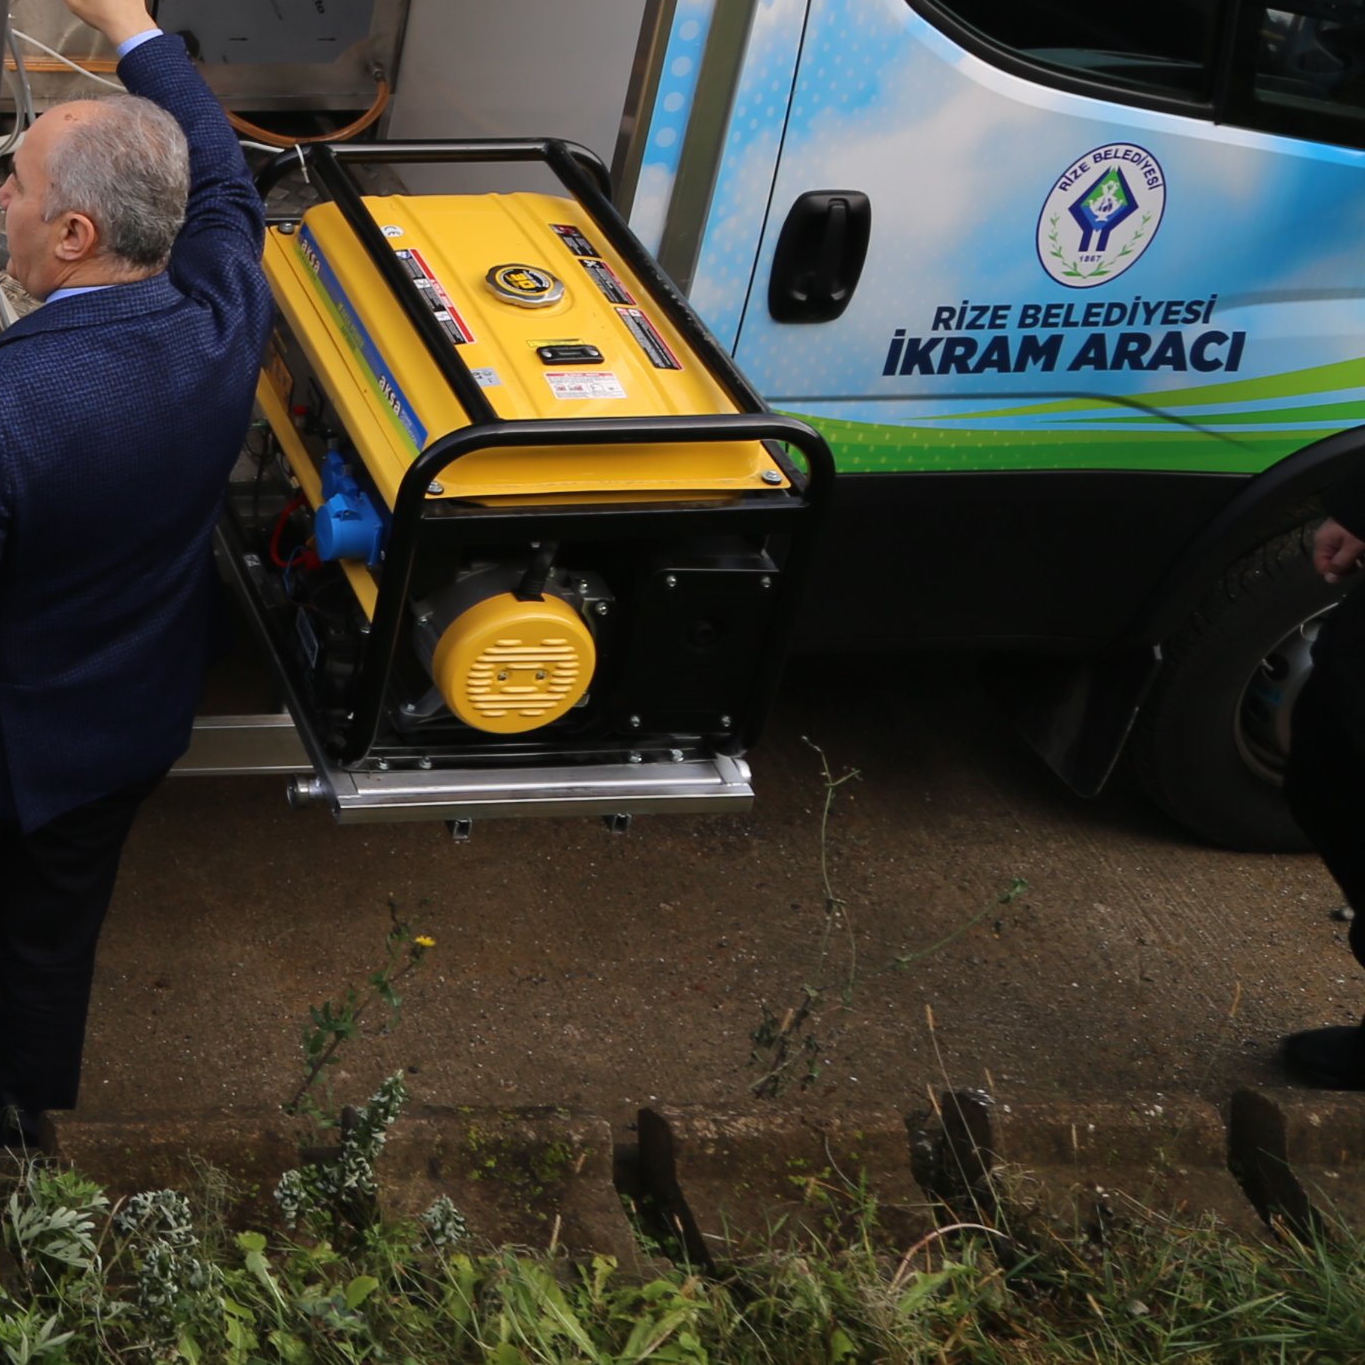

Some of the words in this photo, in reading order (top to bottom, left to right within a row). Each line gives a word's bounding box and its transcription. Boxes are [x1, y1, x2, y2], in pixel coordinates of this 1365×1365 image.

[1059, 161, 1091, 192] RİZE
[1079, 254, 1101, 263] 1867
[932, 299, 1012, 331] RİZE
[1017, 293, 1218, 330] BELEDİYESİ
[882, 329, 1063, 377] İKRAM
[1066, 331, 1247, 373] ARACI
[377, 374, 402, 416] aksa
